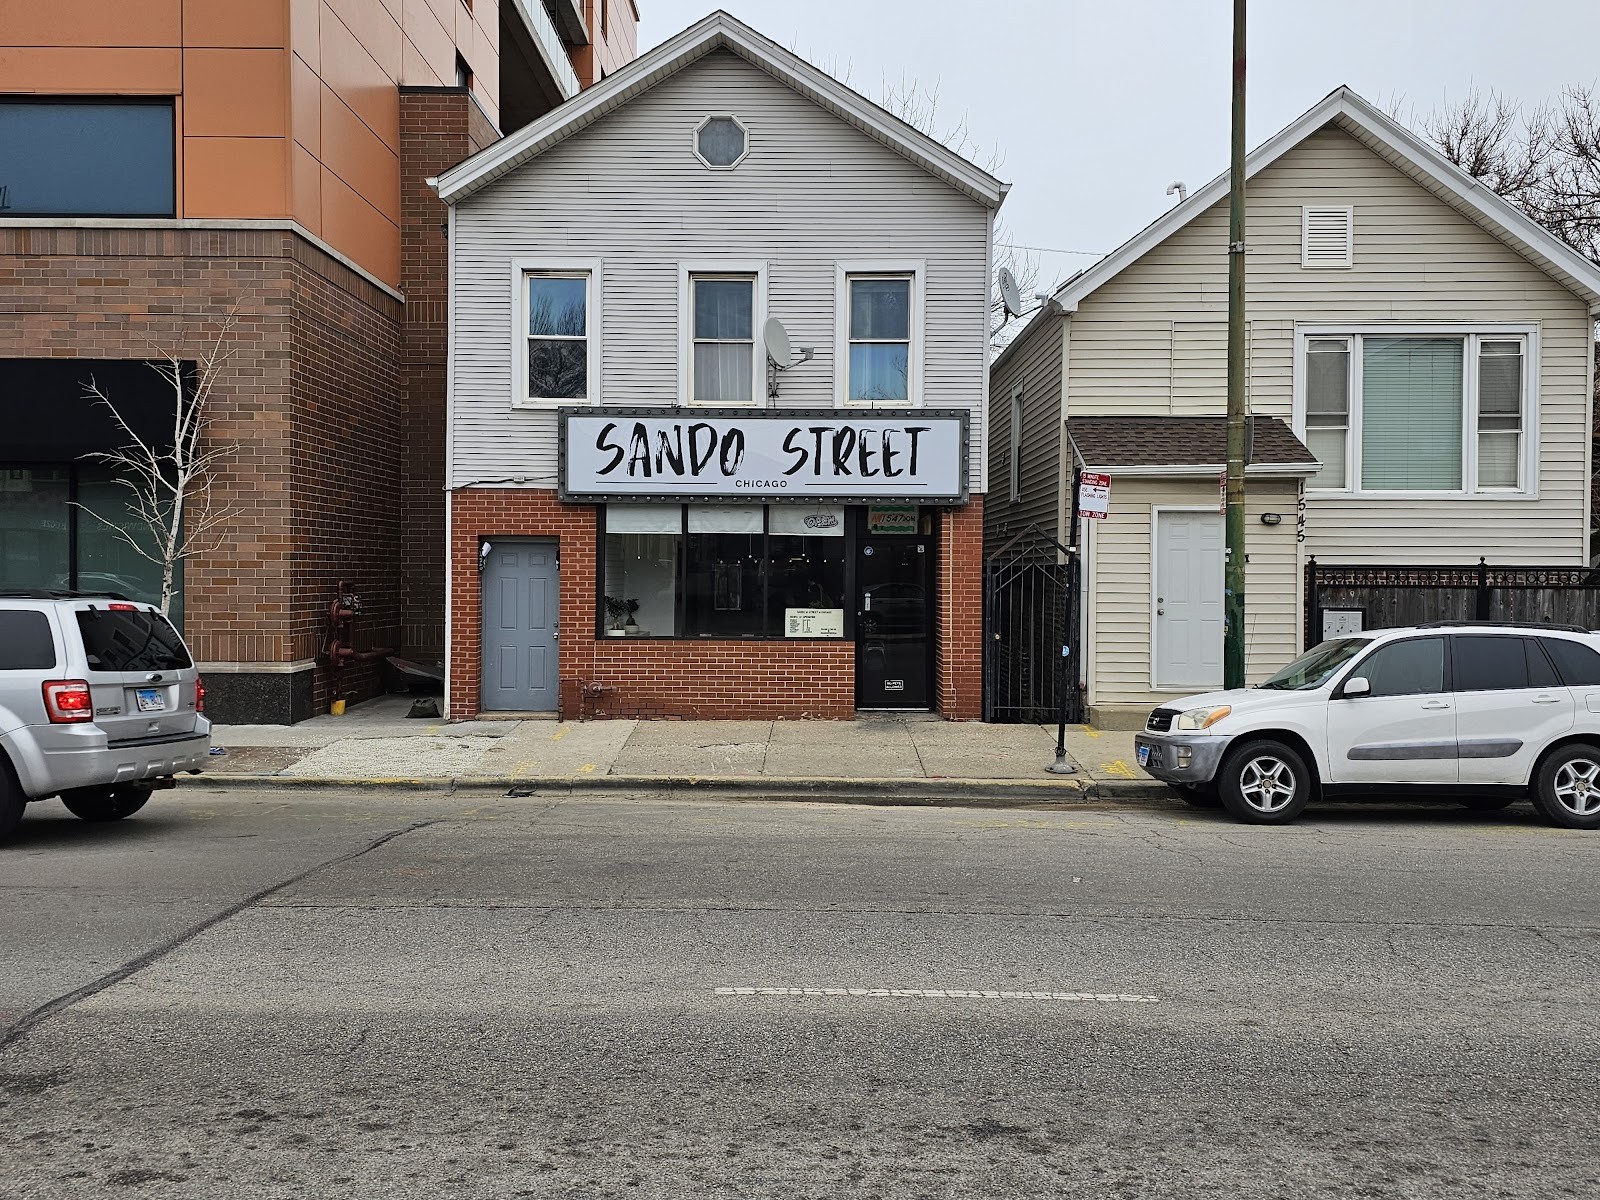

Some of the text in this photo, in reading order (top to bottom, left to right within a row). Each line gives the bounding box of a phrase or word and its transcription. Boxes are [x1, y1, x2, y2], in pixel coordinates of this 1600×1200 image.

[596, 422, 931, 477] SANDO STREET
[735, 479, 788, 488] CHICAGO
[1297, 482, 1306, 542] 1545
